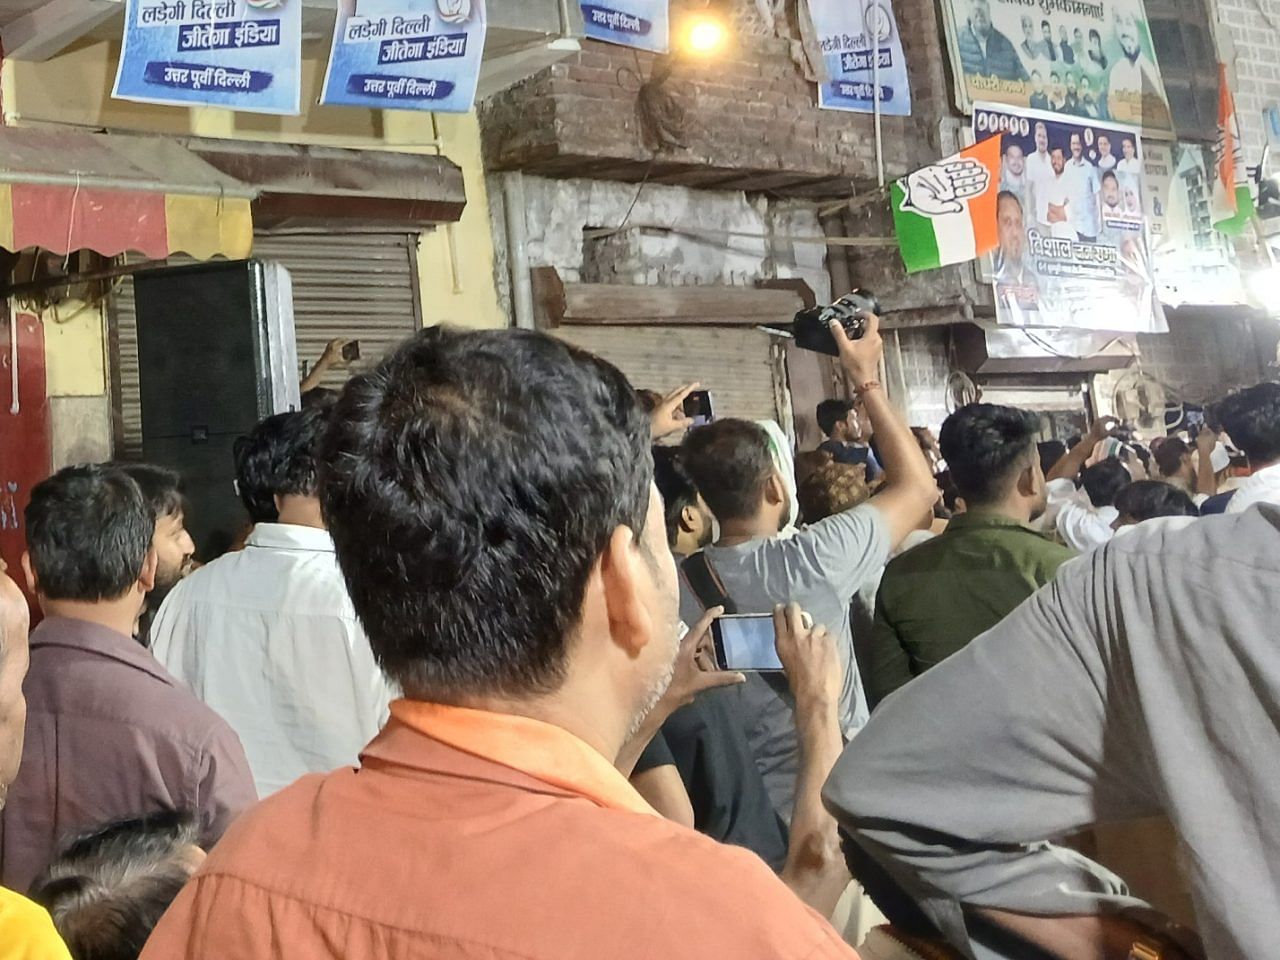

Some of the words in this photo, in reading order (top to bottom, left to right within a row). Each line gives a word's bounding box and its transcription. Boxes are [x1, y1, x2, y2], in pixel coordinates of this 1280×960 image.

[142, 1, 186, 24] लड़ेगी
[182, 25, 230, 48] जीतेगा
[234, 22, 278, 47] इंडिया
[349, 18, 387, 40] लड़ेगी
[391, 14, 431, 36] दिल्ली
[382, 40, 424, 62] जीतेगा
[426, 35, 465, 59] इंडिया
[164, 67, 188, 82] उत्तर
[191, 67, 214, 89] पूर्वी
[214, 69, 251, 88] दिल्ली
[364, 79, 384, 93] उत्तर
[386, 78, 405, 98] पूर्वी
[405, 79, 436, 96] दिल्ली
[1028, 228, 1072, 259] विशाल
